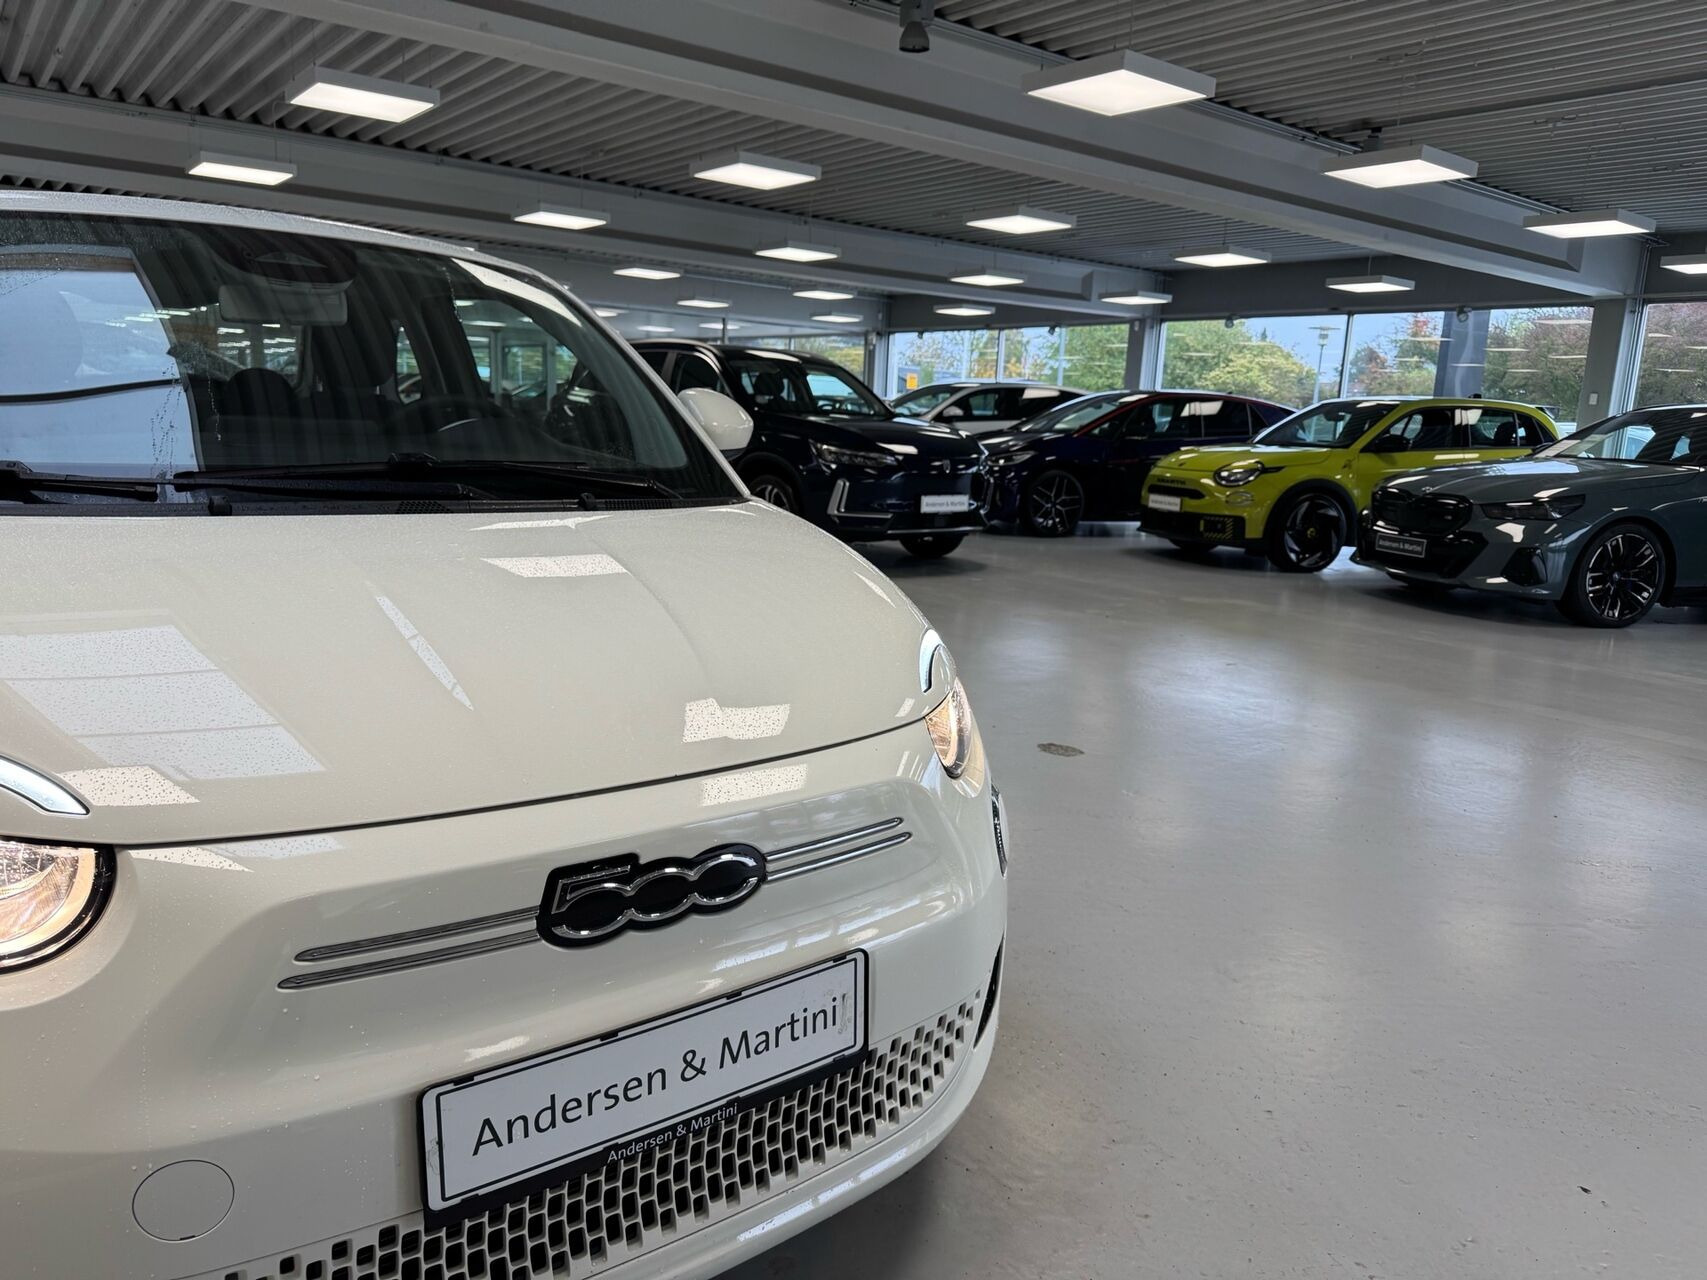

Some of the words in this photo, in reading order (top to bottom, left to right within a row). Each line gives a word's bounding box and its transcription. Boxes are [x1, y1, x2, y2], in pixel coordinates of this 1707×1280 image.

[547, 849, 761, 942] 500
[472, 1067, 667, 1156] Andersen
[680, 1049, 706, 1082] &
[719, 996, 837, 1069] Martini
[607, 1131, 672, 1164] Andersen
[676, 1124, 687, 1136] &
[690, 1103, 738, 1132] Martini
